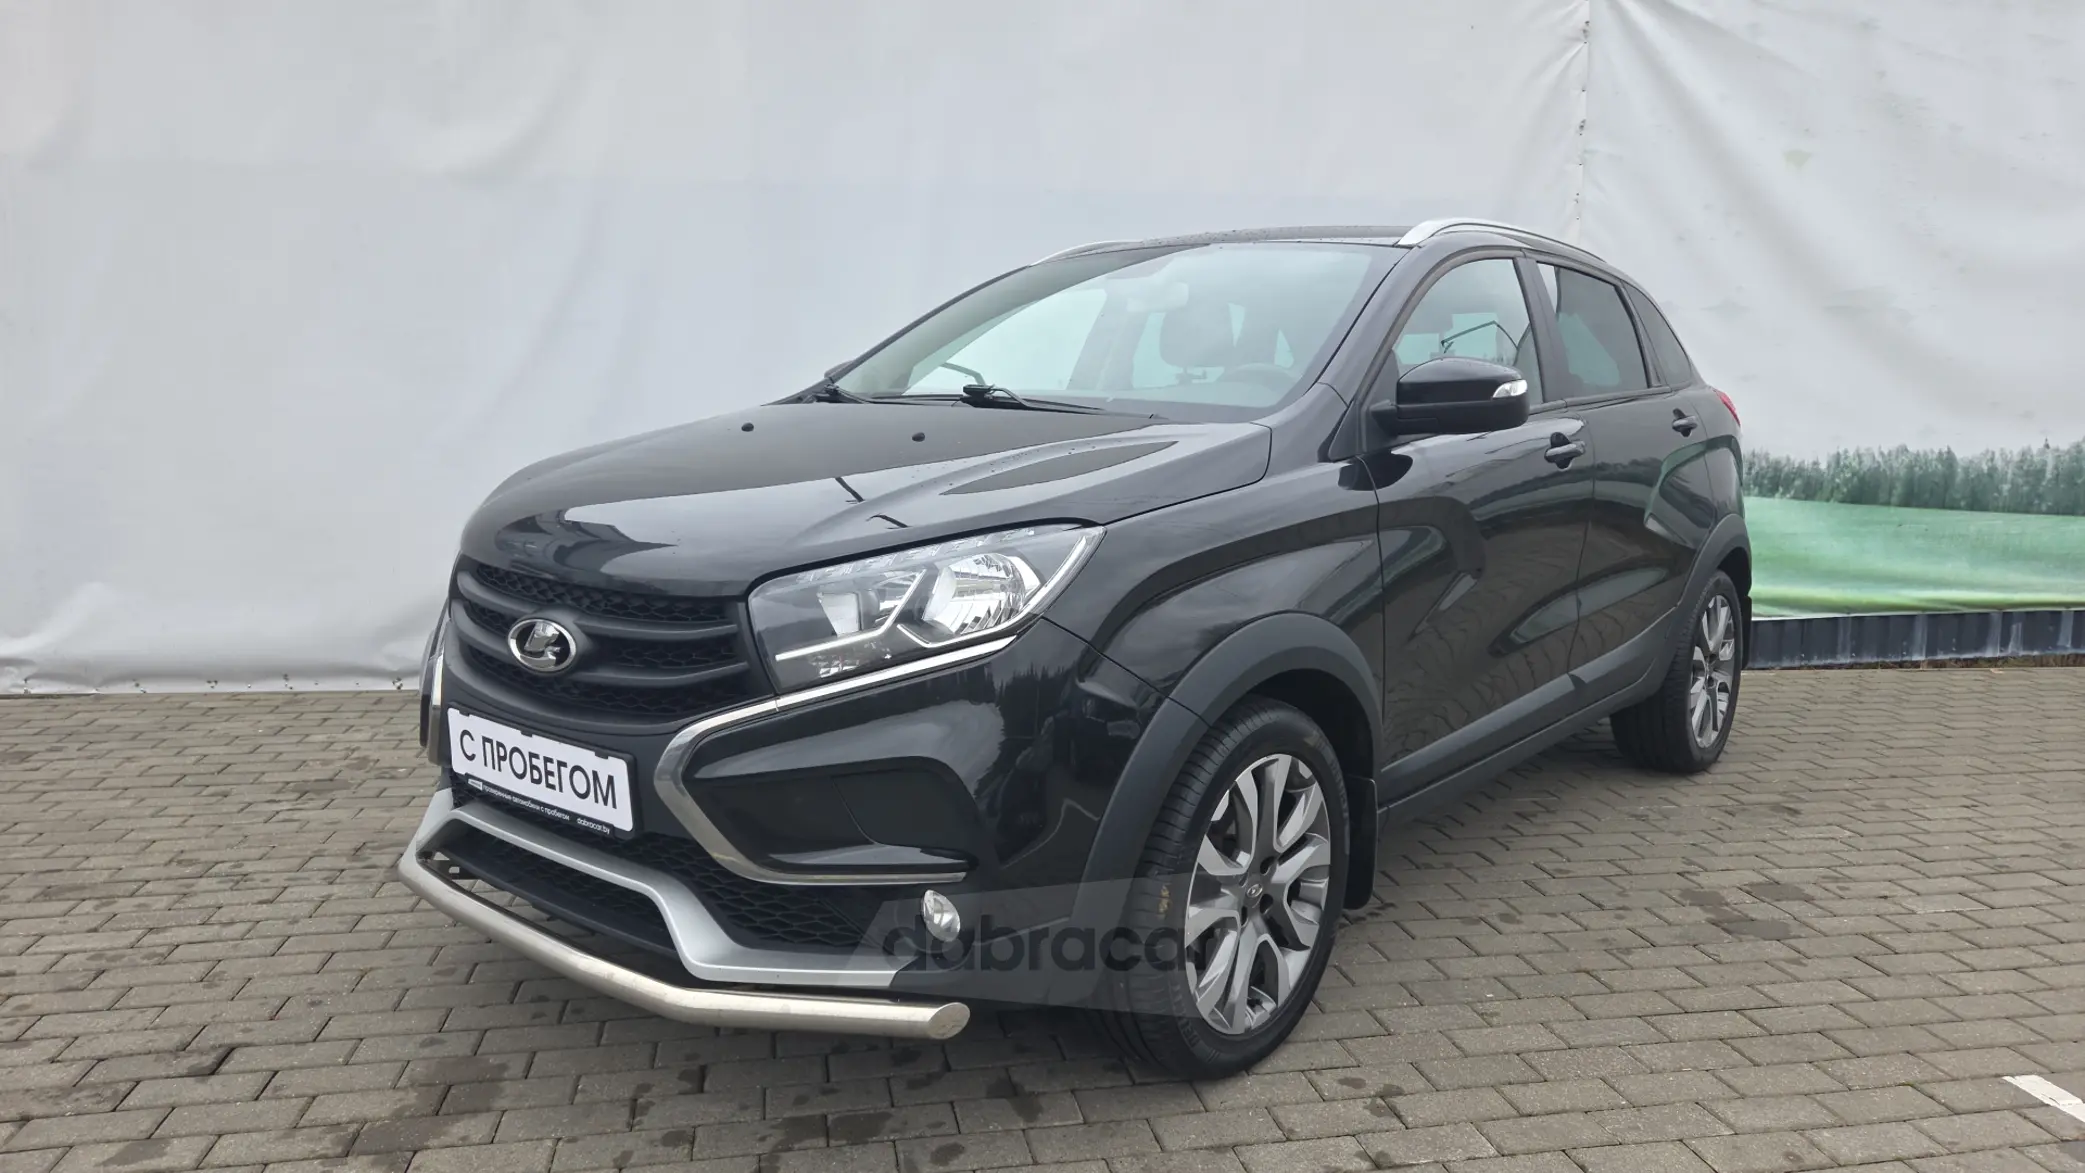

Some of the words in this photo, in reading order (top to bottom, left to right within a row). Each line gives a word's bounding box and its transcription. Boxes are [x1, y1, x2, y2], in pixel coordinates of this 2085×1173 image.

[459, 729, 477, 762] С
[481, 735, 618, 810] ПРОБЕГОМ
[544, 806, 570, 821] пробегом
[576, 817, 611, 835] dabracar.by
